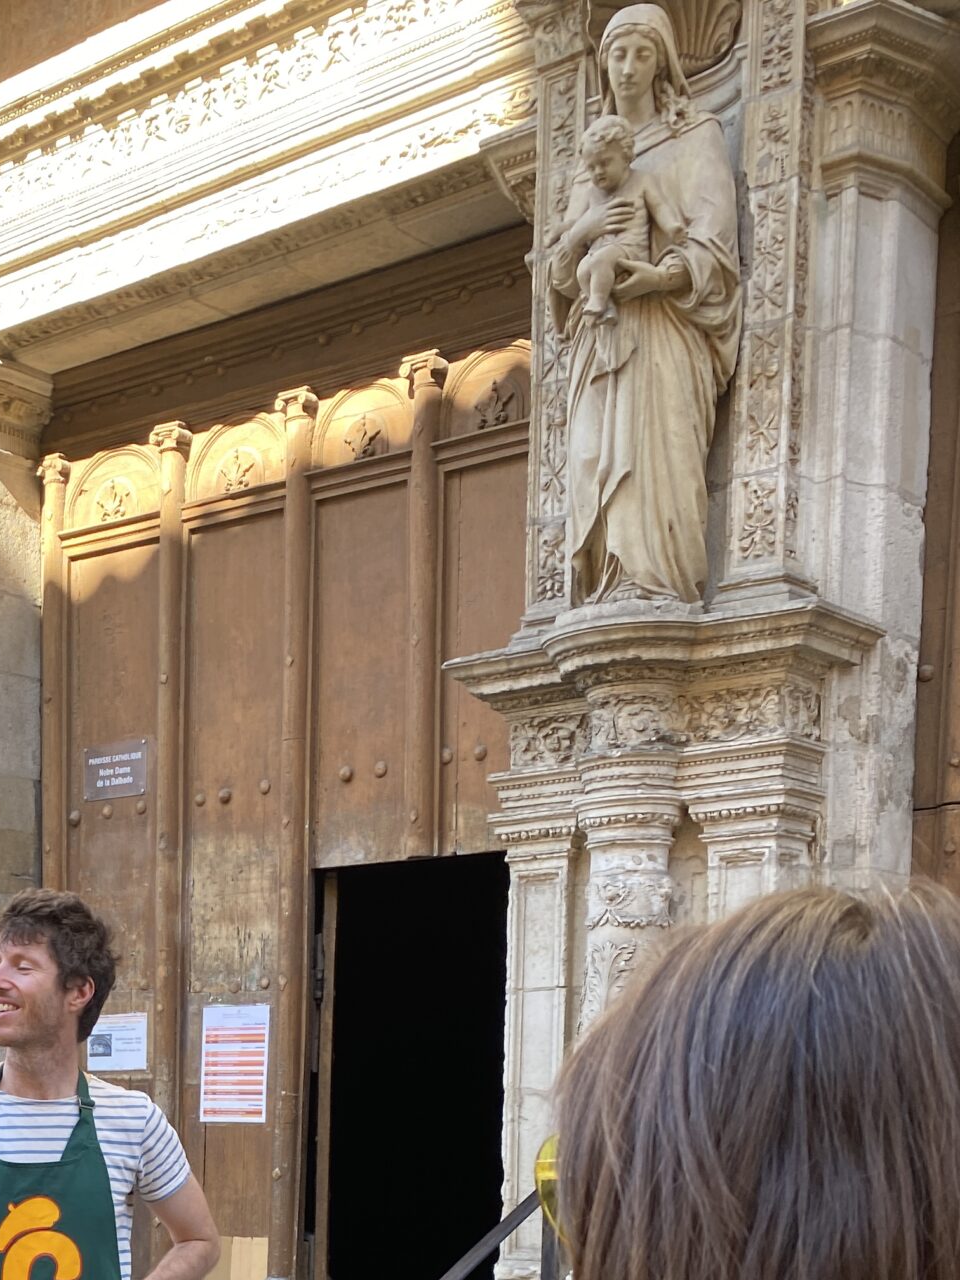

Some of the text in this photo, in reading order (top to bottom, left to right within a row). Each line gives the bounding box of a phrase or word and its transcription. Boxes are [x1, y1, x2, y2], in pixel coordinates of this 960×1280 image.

[112, 751, 142, 763] CATHOLIQUE
[99, 766, 131, 777] Notre Dame
[96, 779, 104, 788] de
